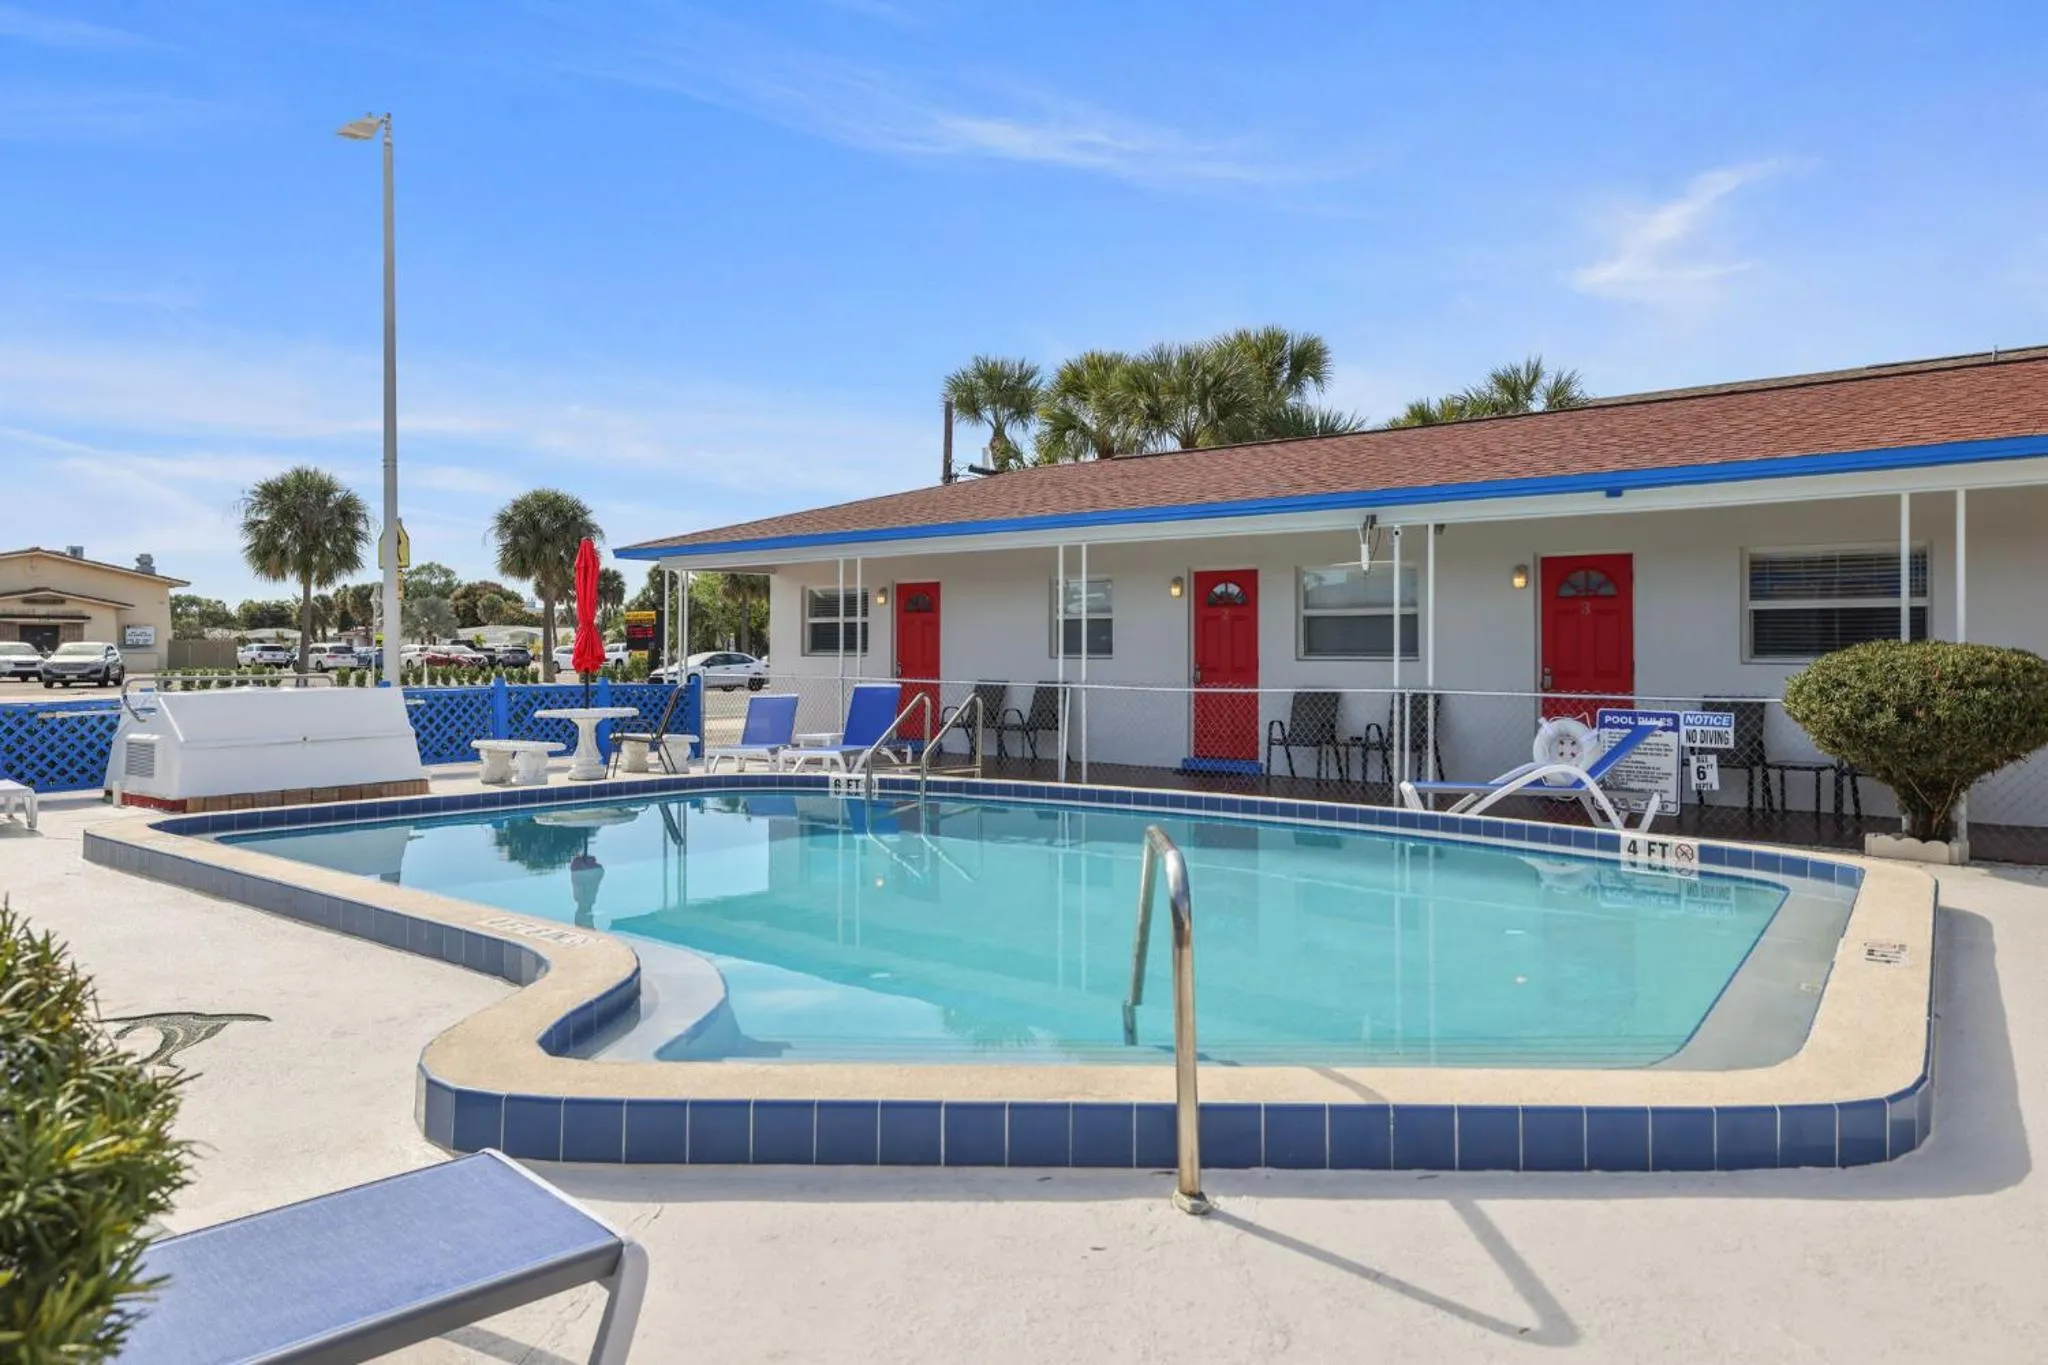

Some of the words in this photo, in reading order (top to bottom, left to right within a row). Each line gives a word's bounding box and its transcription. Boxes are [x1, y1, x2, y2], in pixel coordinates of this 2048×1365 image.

[1604, 715, 1635, 725] POOL
[1685, 714, 1731, 726] NOTICE
[1686, 729, 1698, 744] NO
[1700, 729, 1730, 746] DIVING
[1696, 765, 1707, 781] 6
[847, 779, 861, 789] FT
[1627, 840, 1639, 856] 4
[1647, 841, 1670, 859] FT
